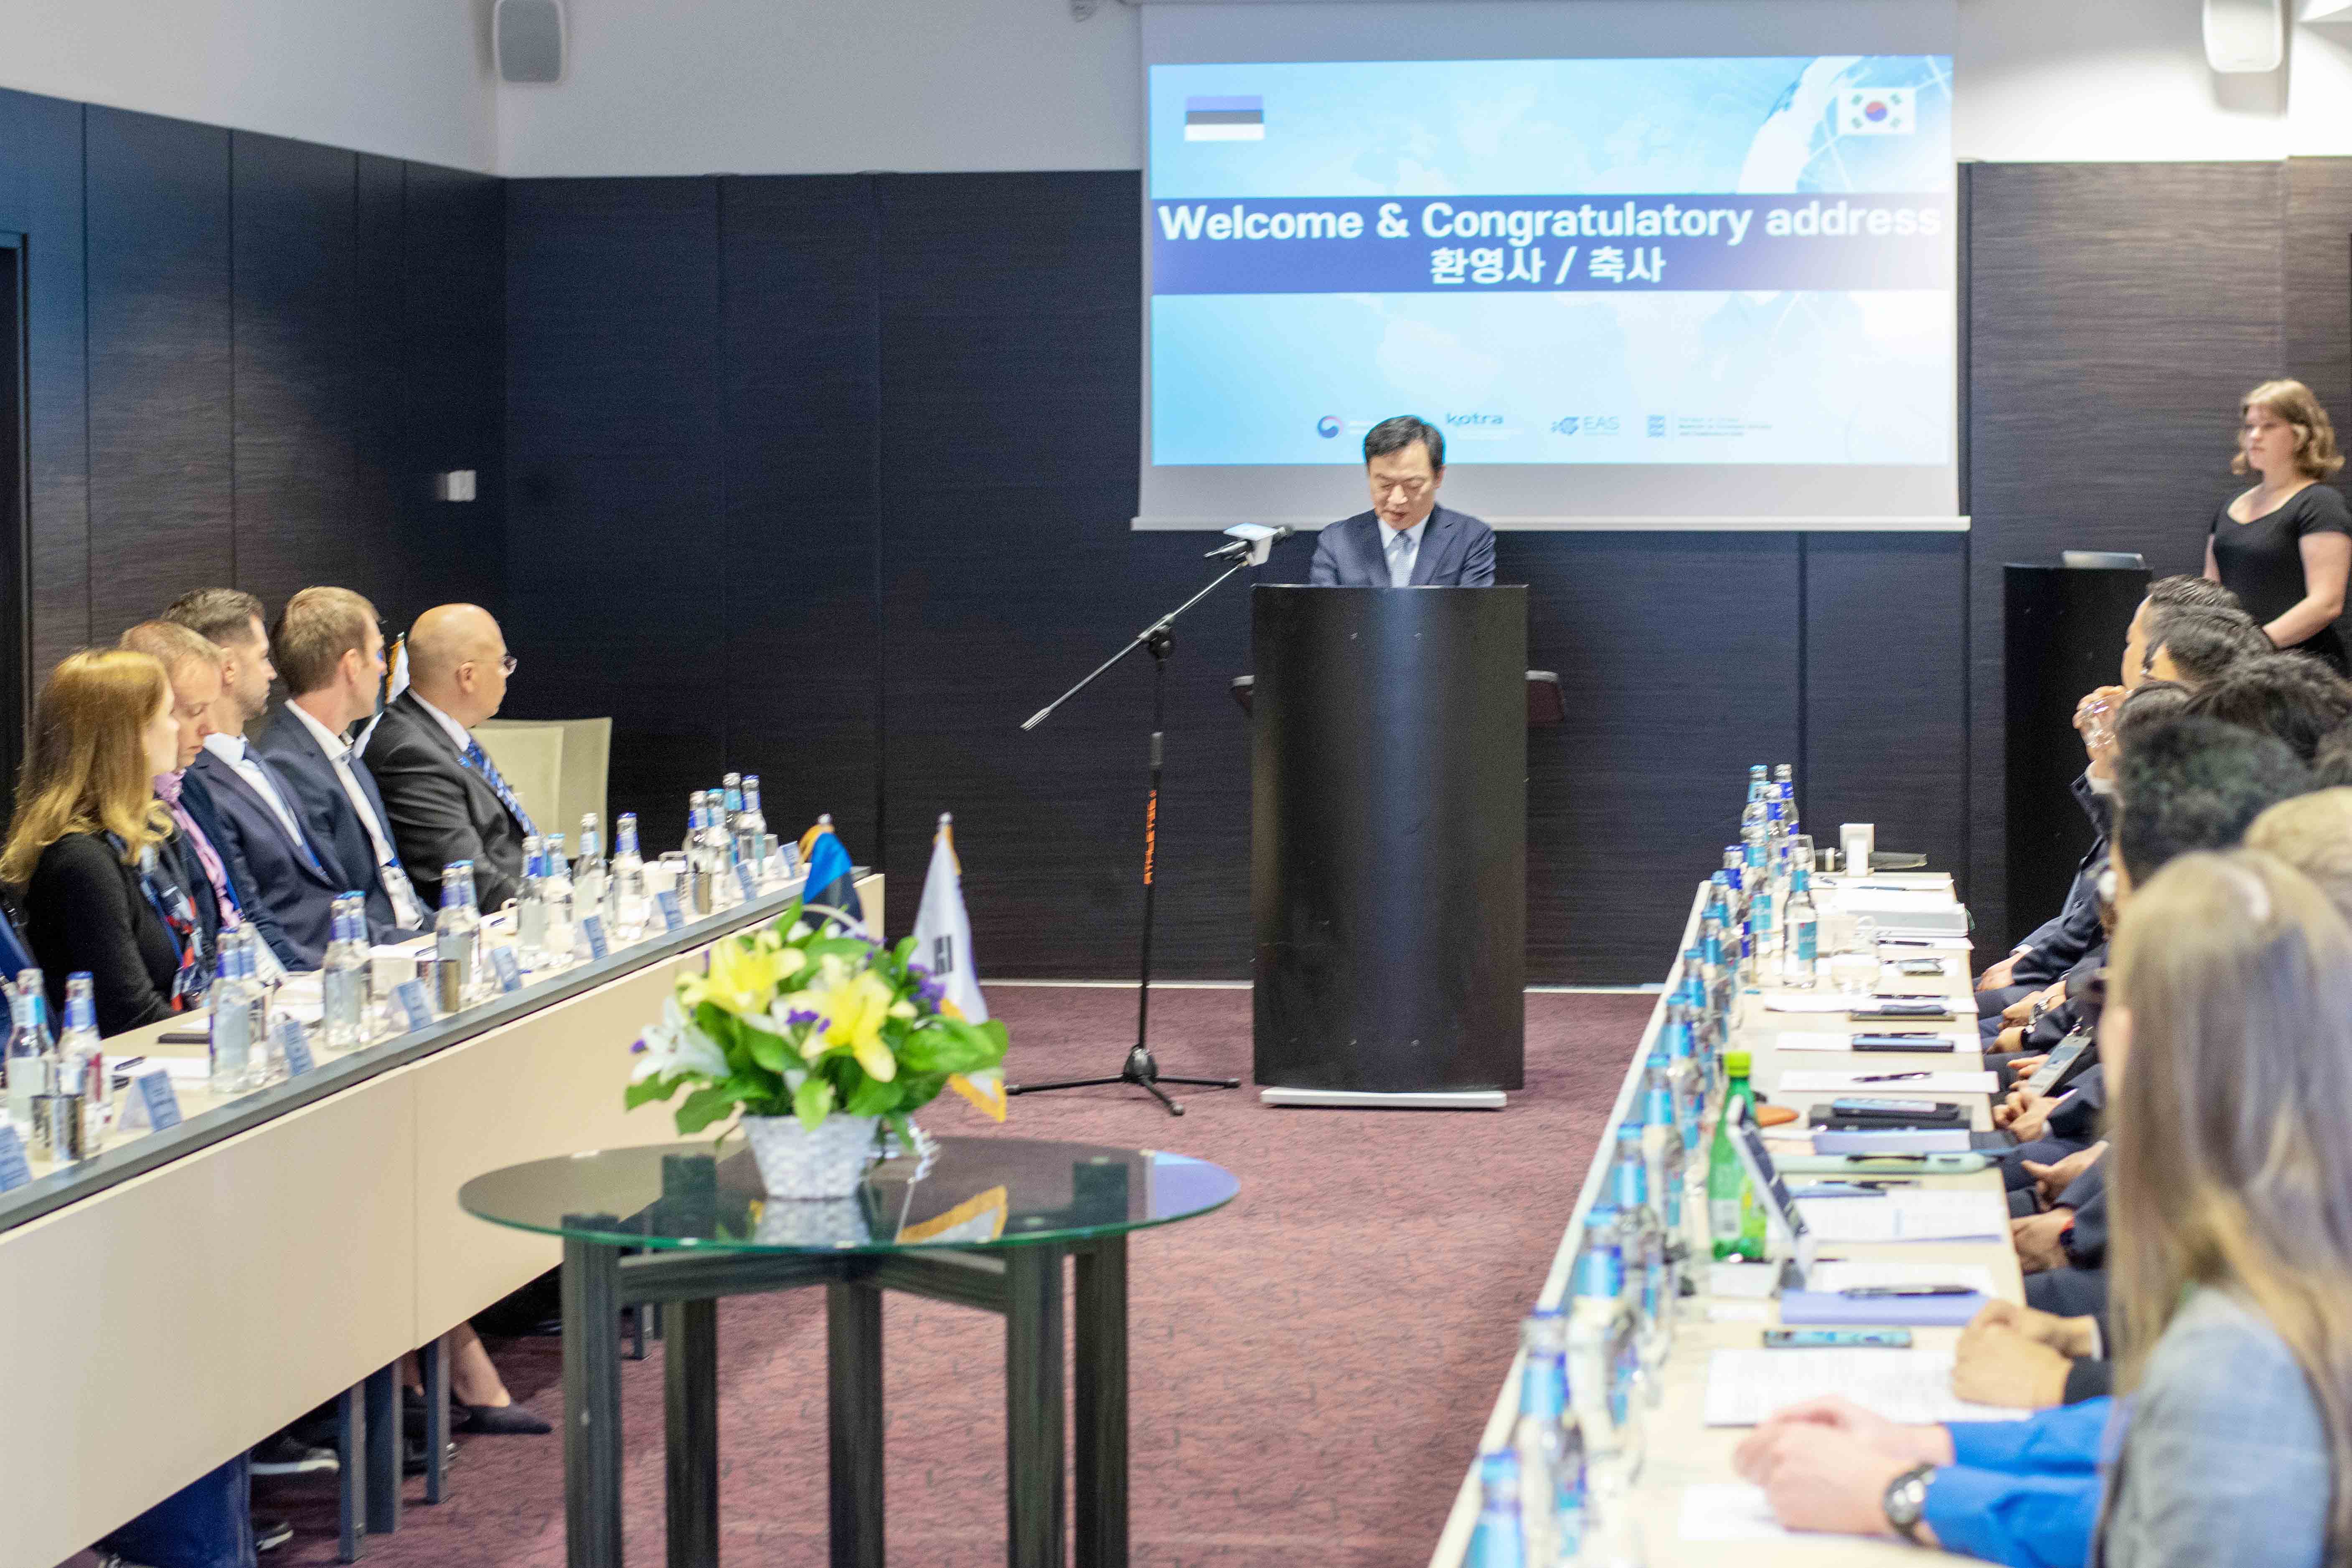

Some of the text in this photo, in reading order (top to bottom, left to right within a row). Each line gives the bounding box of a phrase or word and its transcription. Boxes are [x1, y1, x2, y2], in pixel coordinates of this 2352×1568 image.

[1158, 200, 1941, 247] Welcome & Congratulatory address
[1430, 246, 1666, 285] 환영사 / 축사
[1446, 411, 1504, 425] kotra
[1584, 416, 1619, 429] EAS
